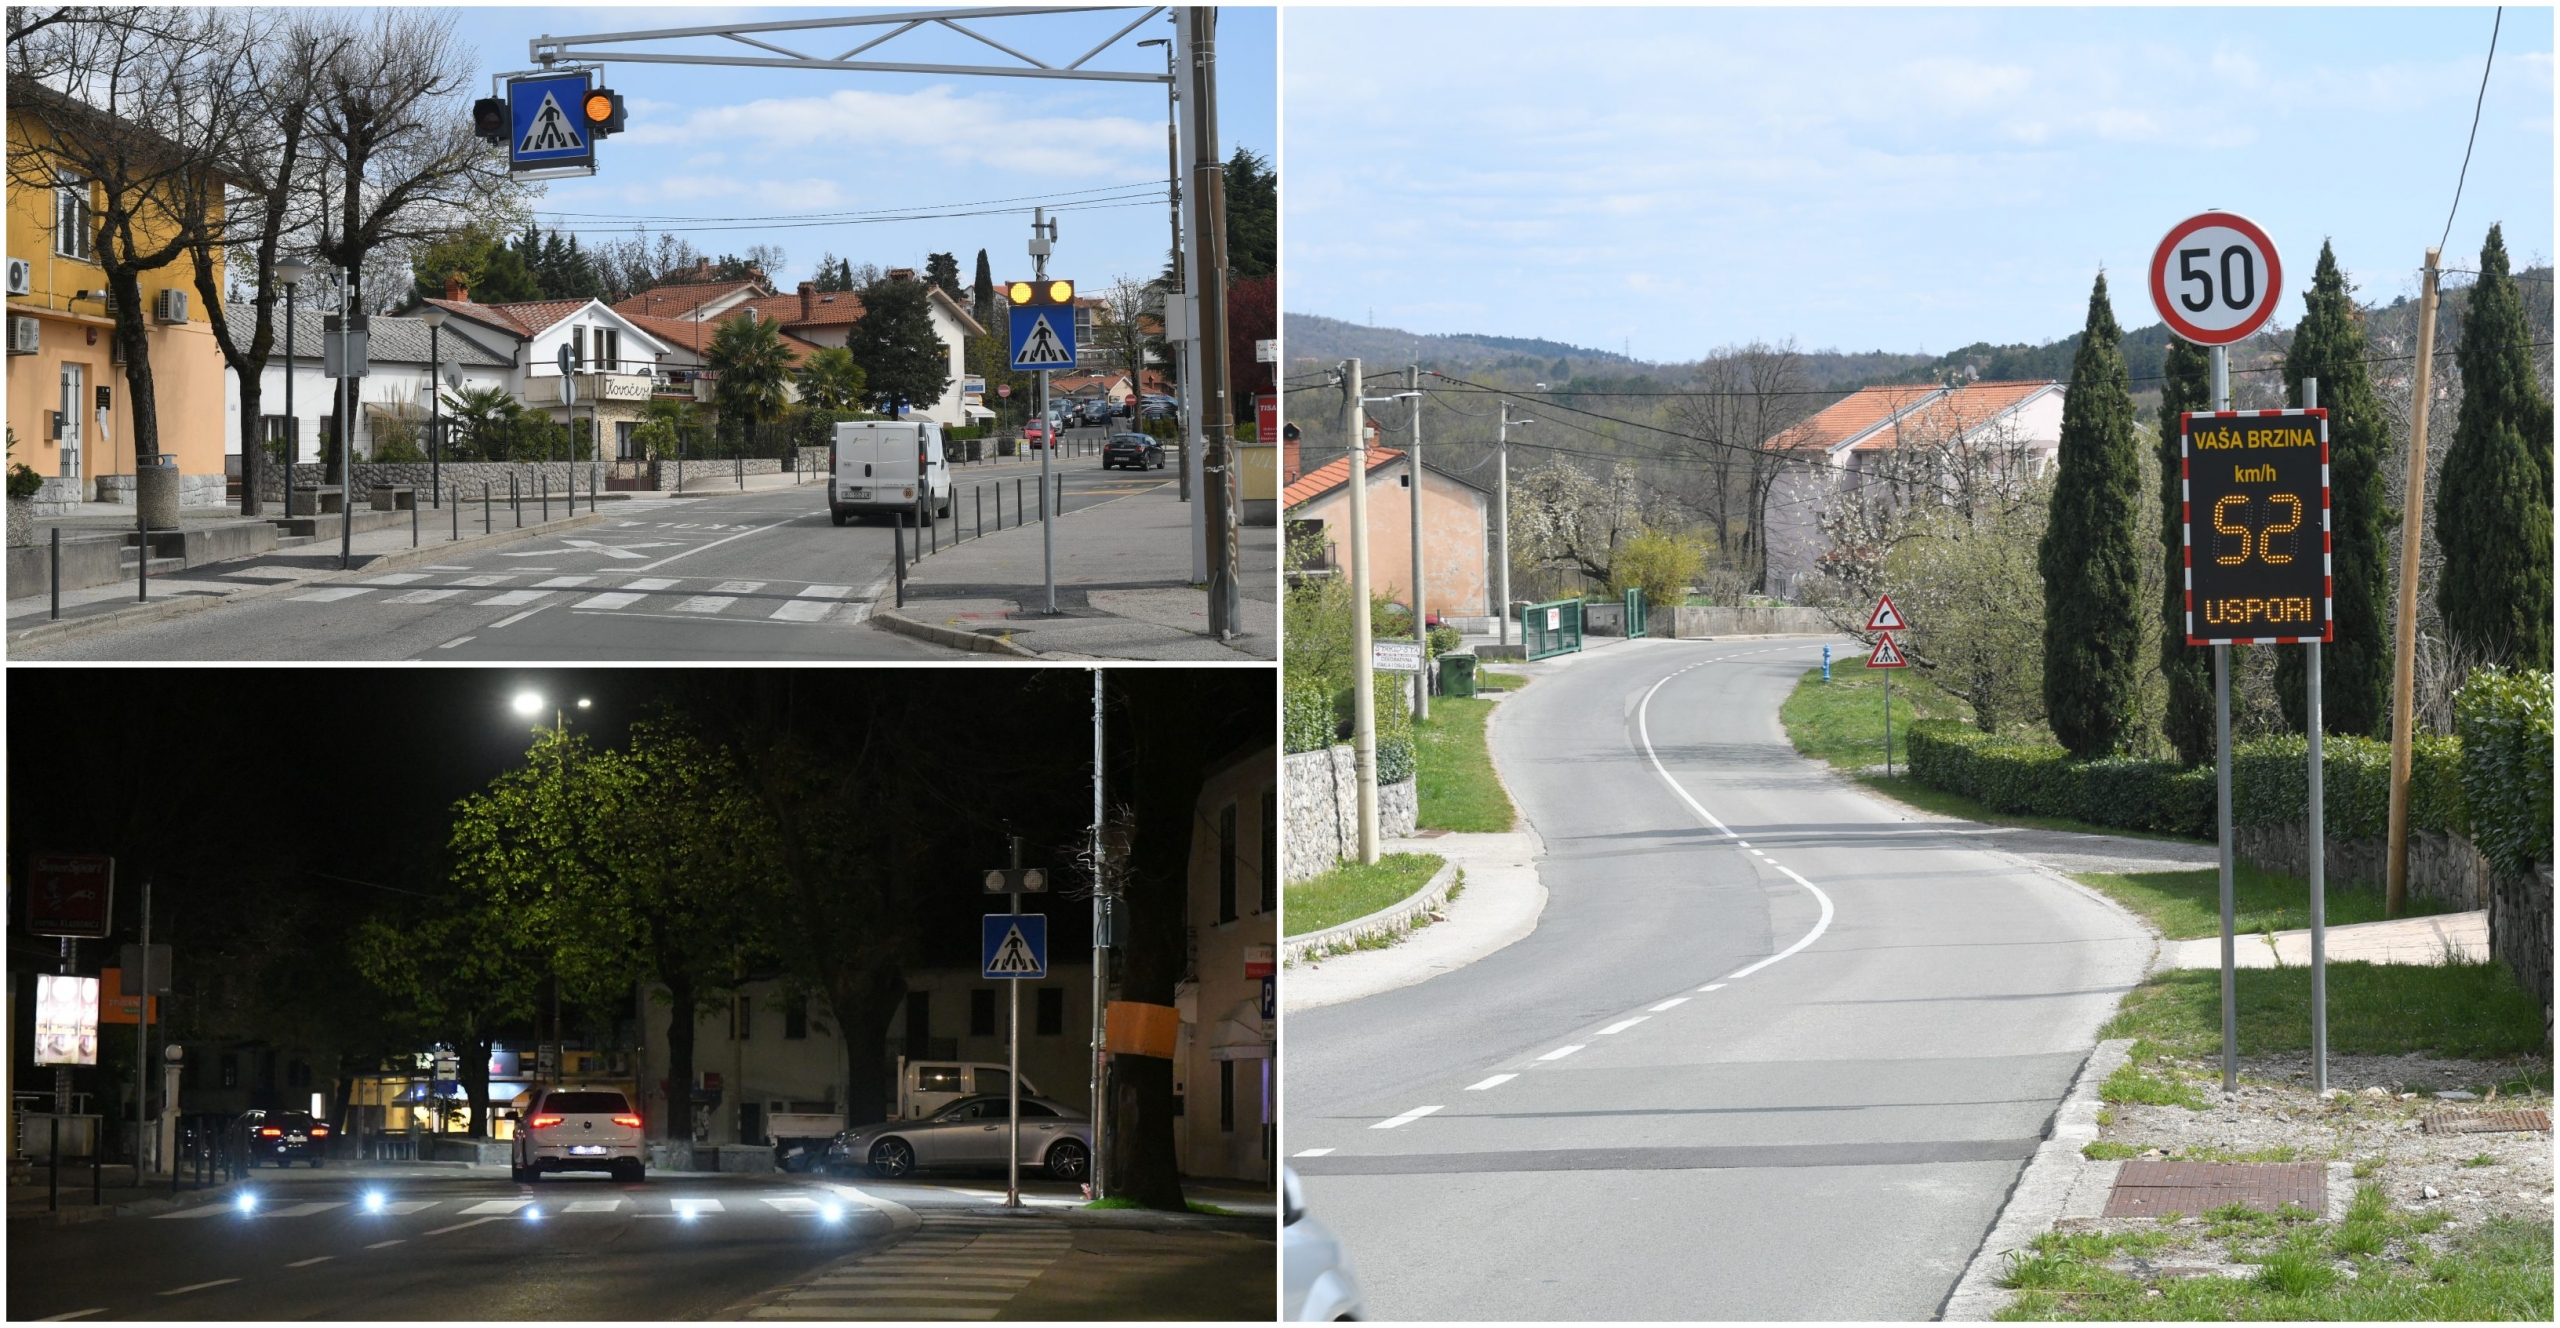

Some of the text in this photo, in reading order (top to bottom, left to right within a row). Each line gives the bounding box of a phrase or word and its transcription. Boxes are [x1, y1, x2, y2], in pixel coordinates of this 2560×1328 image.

[2180, 245, 2254, 312] 50
[2193, 427, 2316, 450] VAŠA BRZINA
[2234, 464, 2277, 482] km/h
[2214, 494, 2302, 565] 52
[2206, 598, 2311, 623] USPORI
